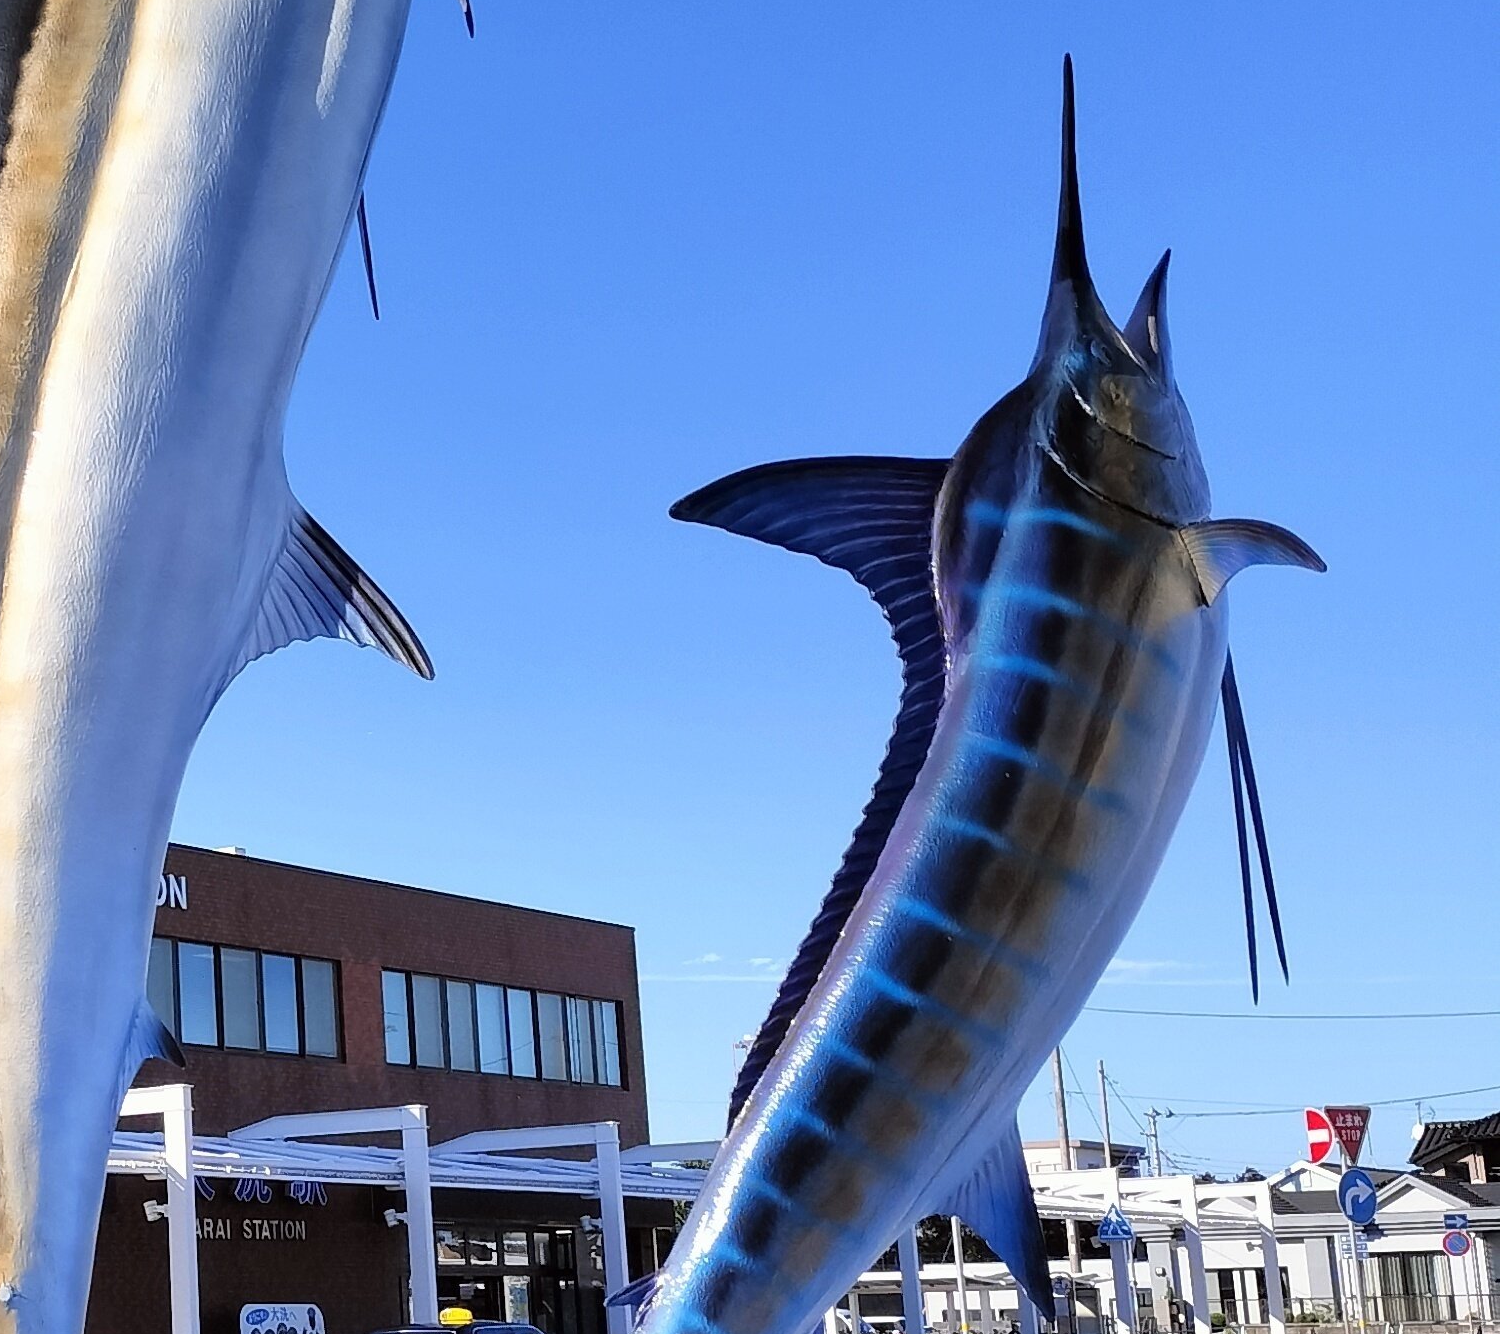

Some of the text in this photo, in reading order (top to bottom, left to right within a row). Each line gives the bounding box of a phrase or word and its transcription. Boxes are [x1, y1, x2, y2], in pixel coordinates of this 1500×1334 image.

[1335, 1113, 1363, 1127] 止まれ
[1342, 1130, 1360, 1141] STOP
[243, 1219, 306, 1240] STATION
